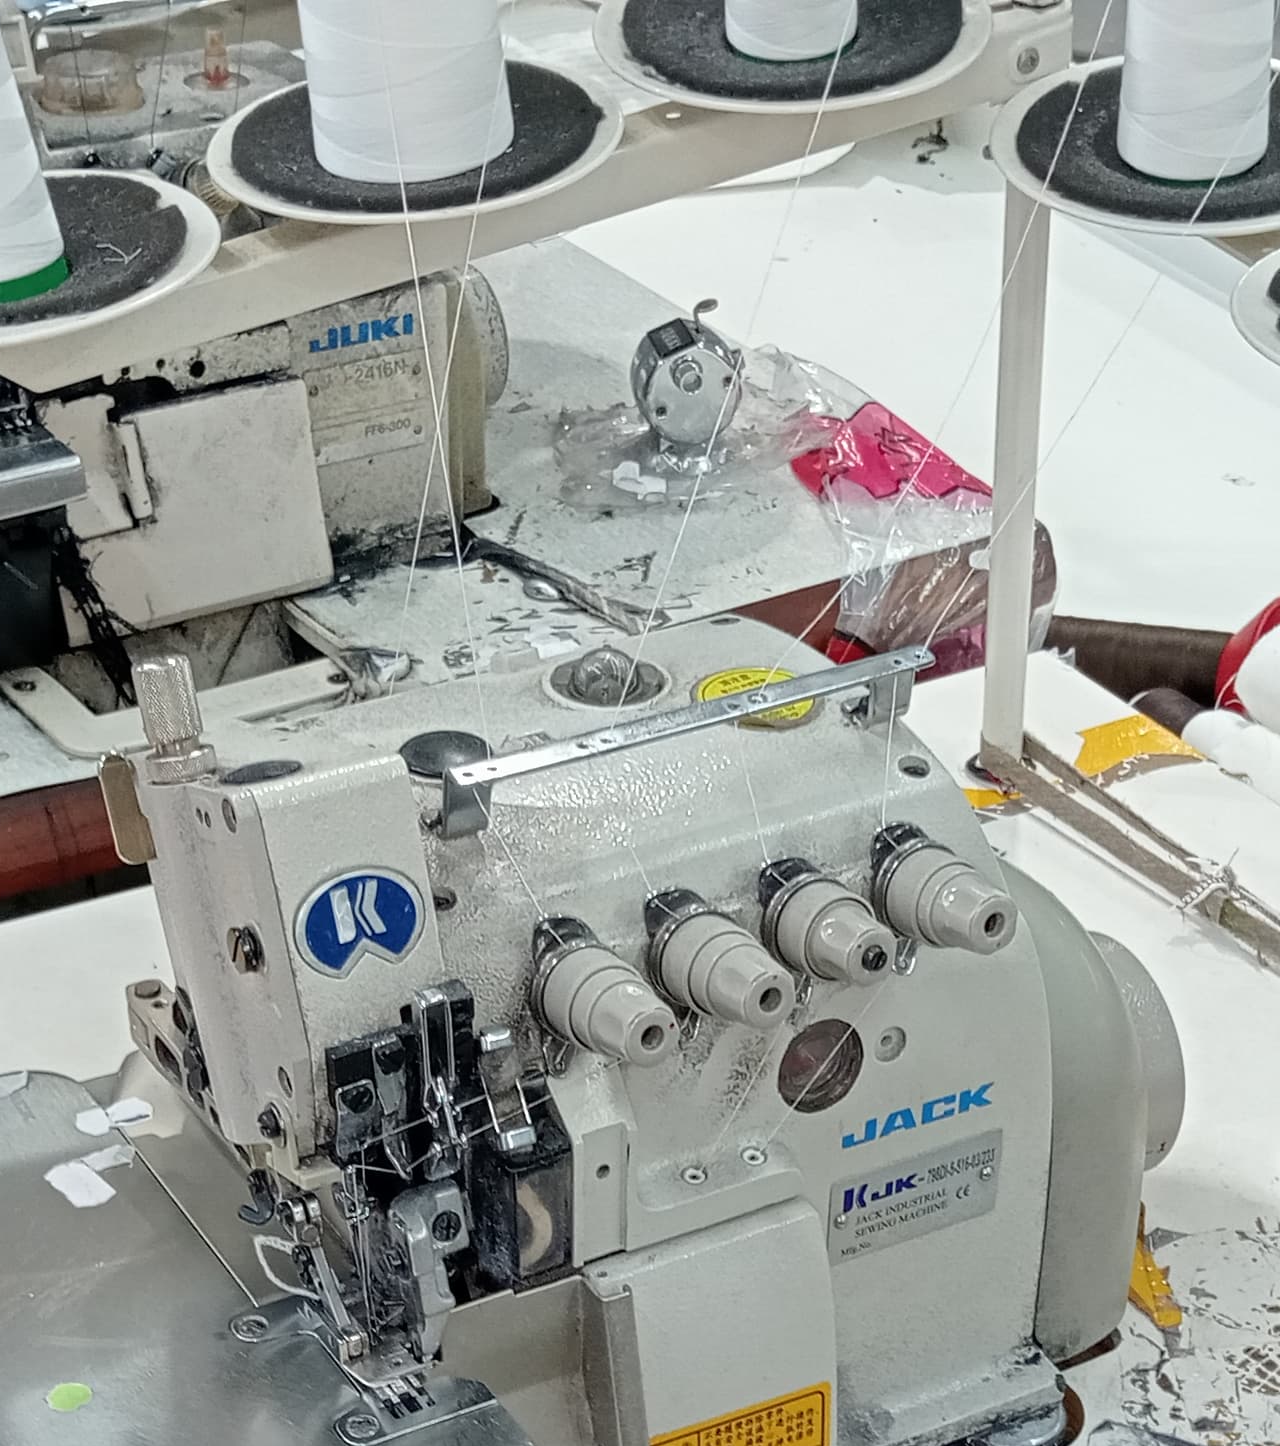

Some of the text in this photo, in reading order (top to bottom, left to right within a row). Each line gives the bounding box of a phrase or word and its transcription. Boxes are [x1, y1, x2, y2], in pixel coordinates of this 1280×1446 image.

[309, 313, 413, 352] JUKI
[841, 1081, 994, 1149] JACK
[854, 1200, 948, 1239] SEWING MACHINE
[885, 1188, 947, 1217] INDUSTRIAL
